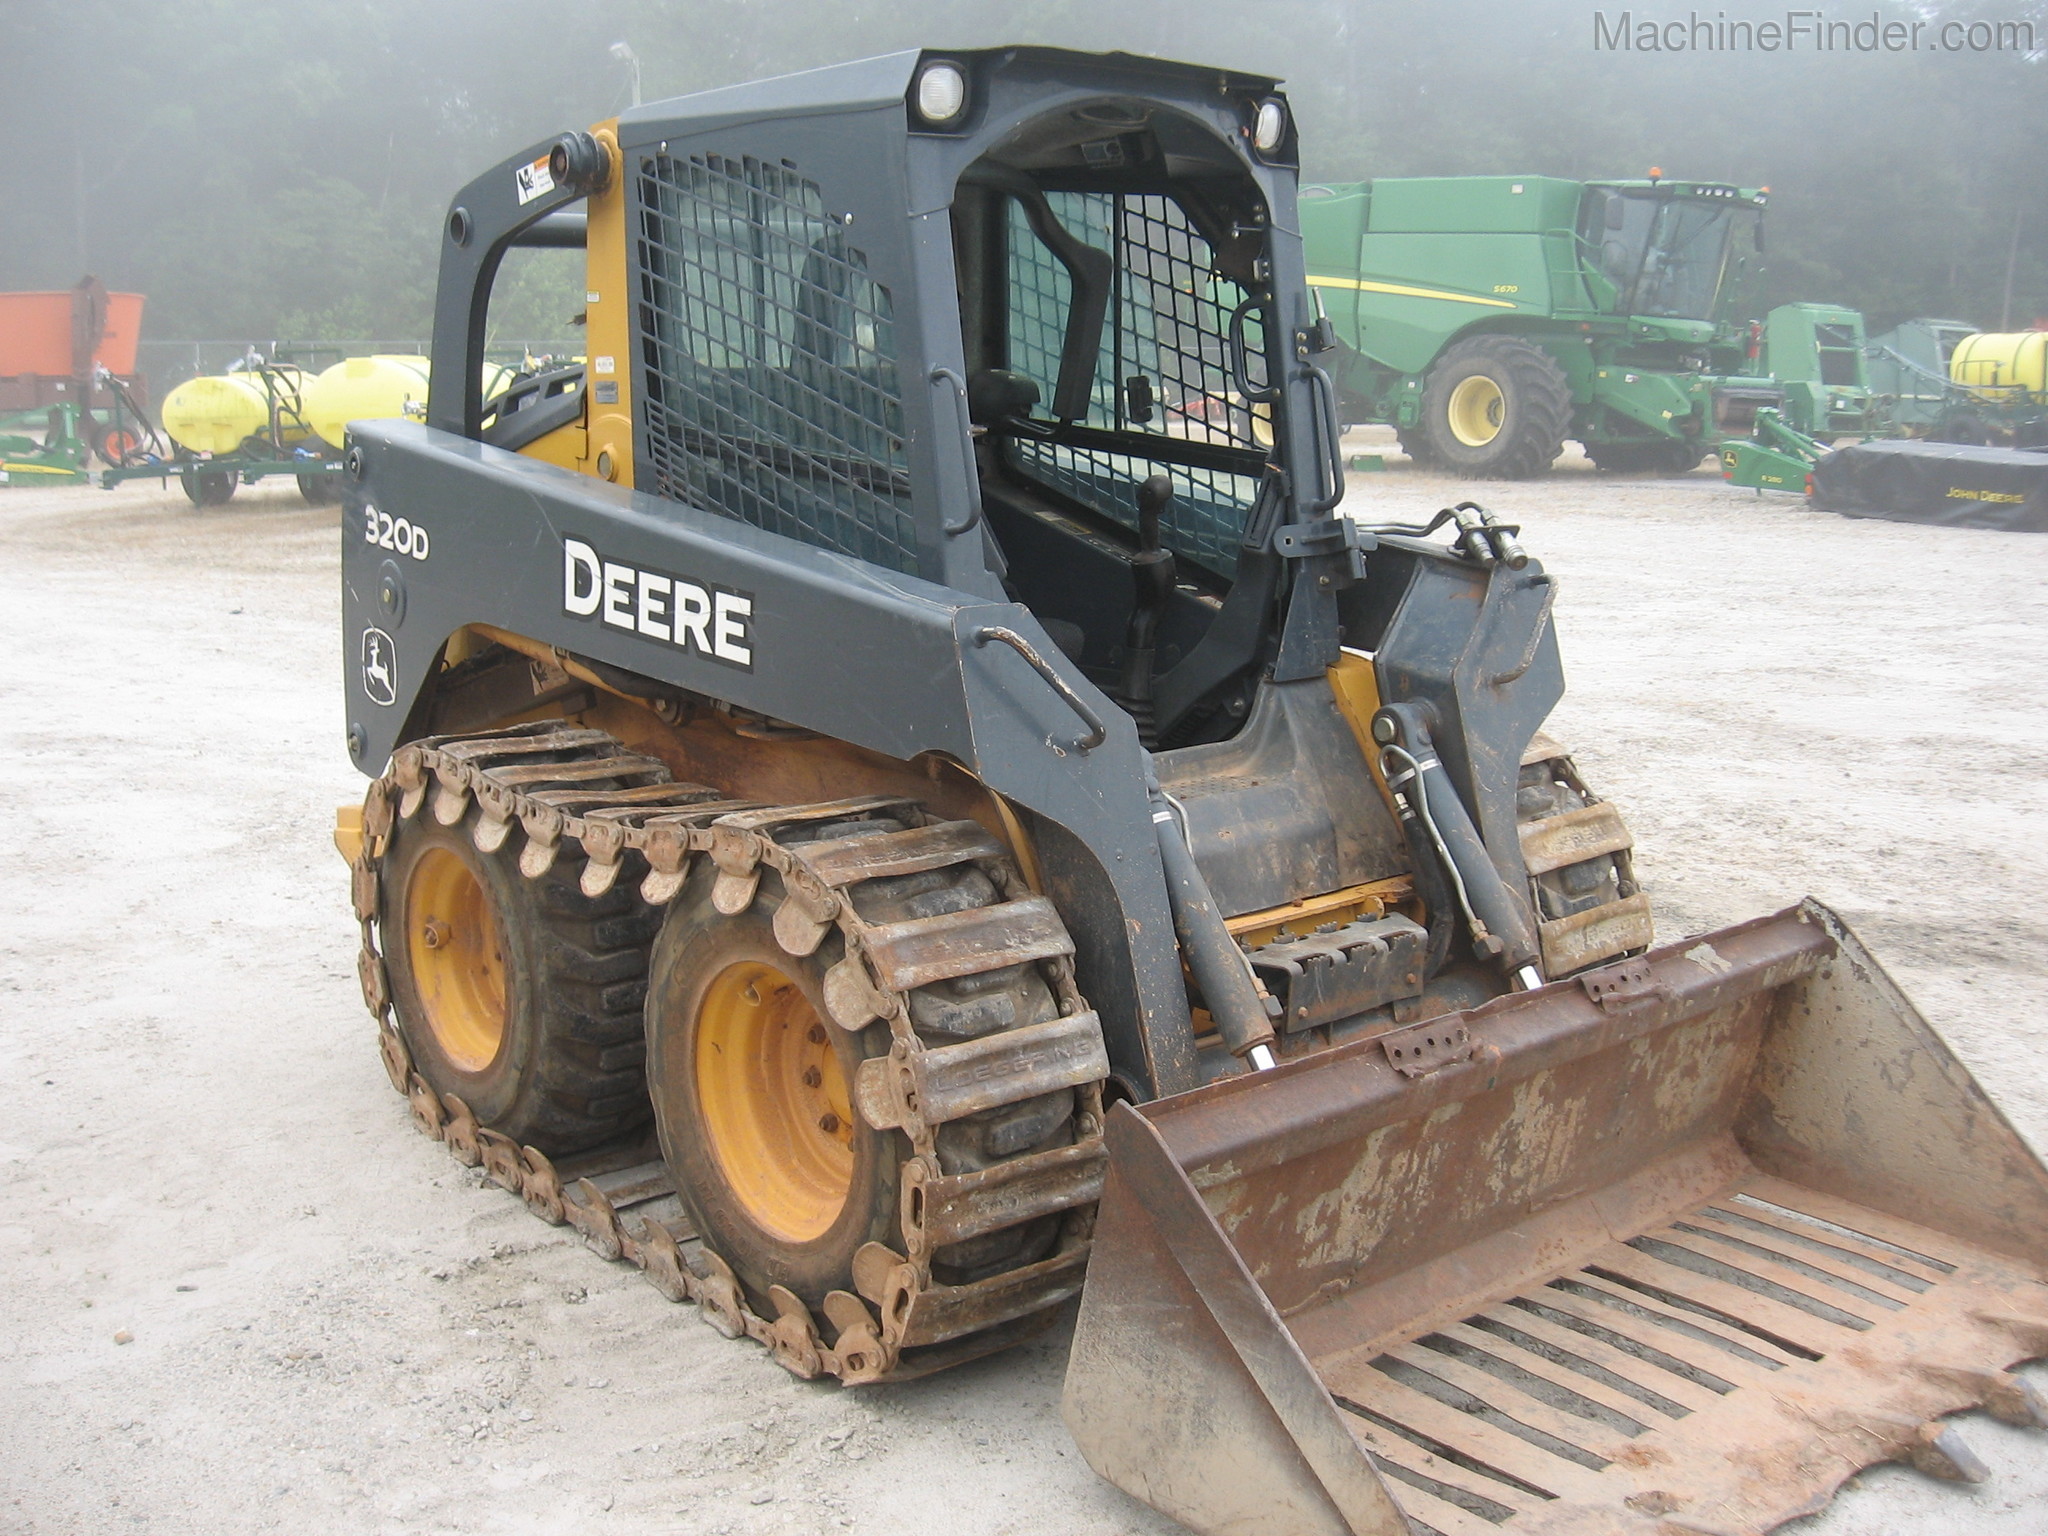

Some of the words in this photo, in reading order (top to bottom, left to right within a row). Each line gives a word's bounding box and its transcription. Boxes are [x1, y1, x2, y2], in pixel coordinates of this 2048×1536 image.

[1493, 285, 1519, 293] S670
[1980, 490, 2025, 503] DEERE
[365, 504, 429, 561] 320D
[565, 538, 751, 666] DEERE
[935, 1039, 1093, 1093] LOEGERNG
